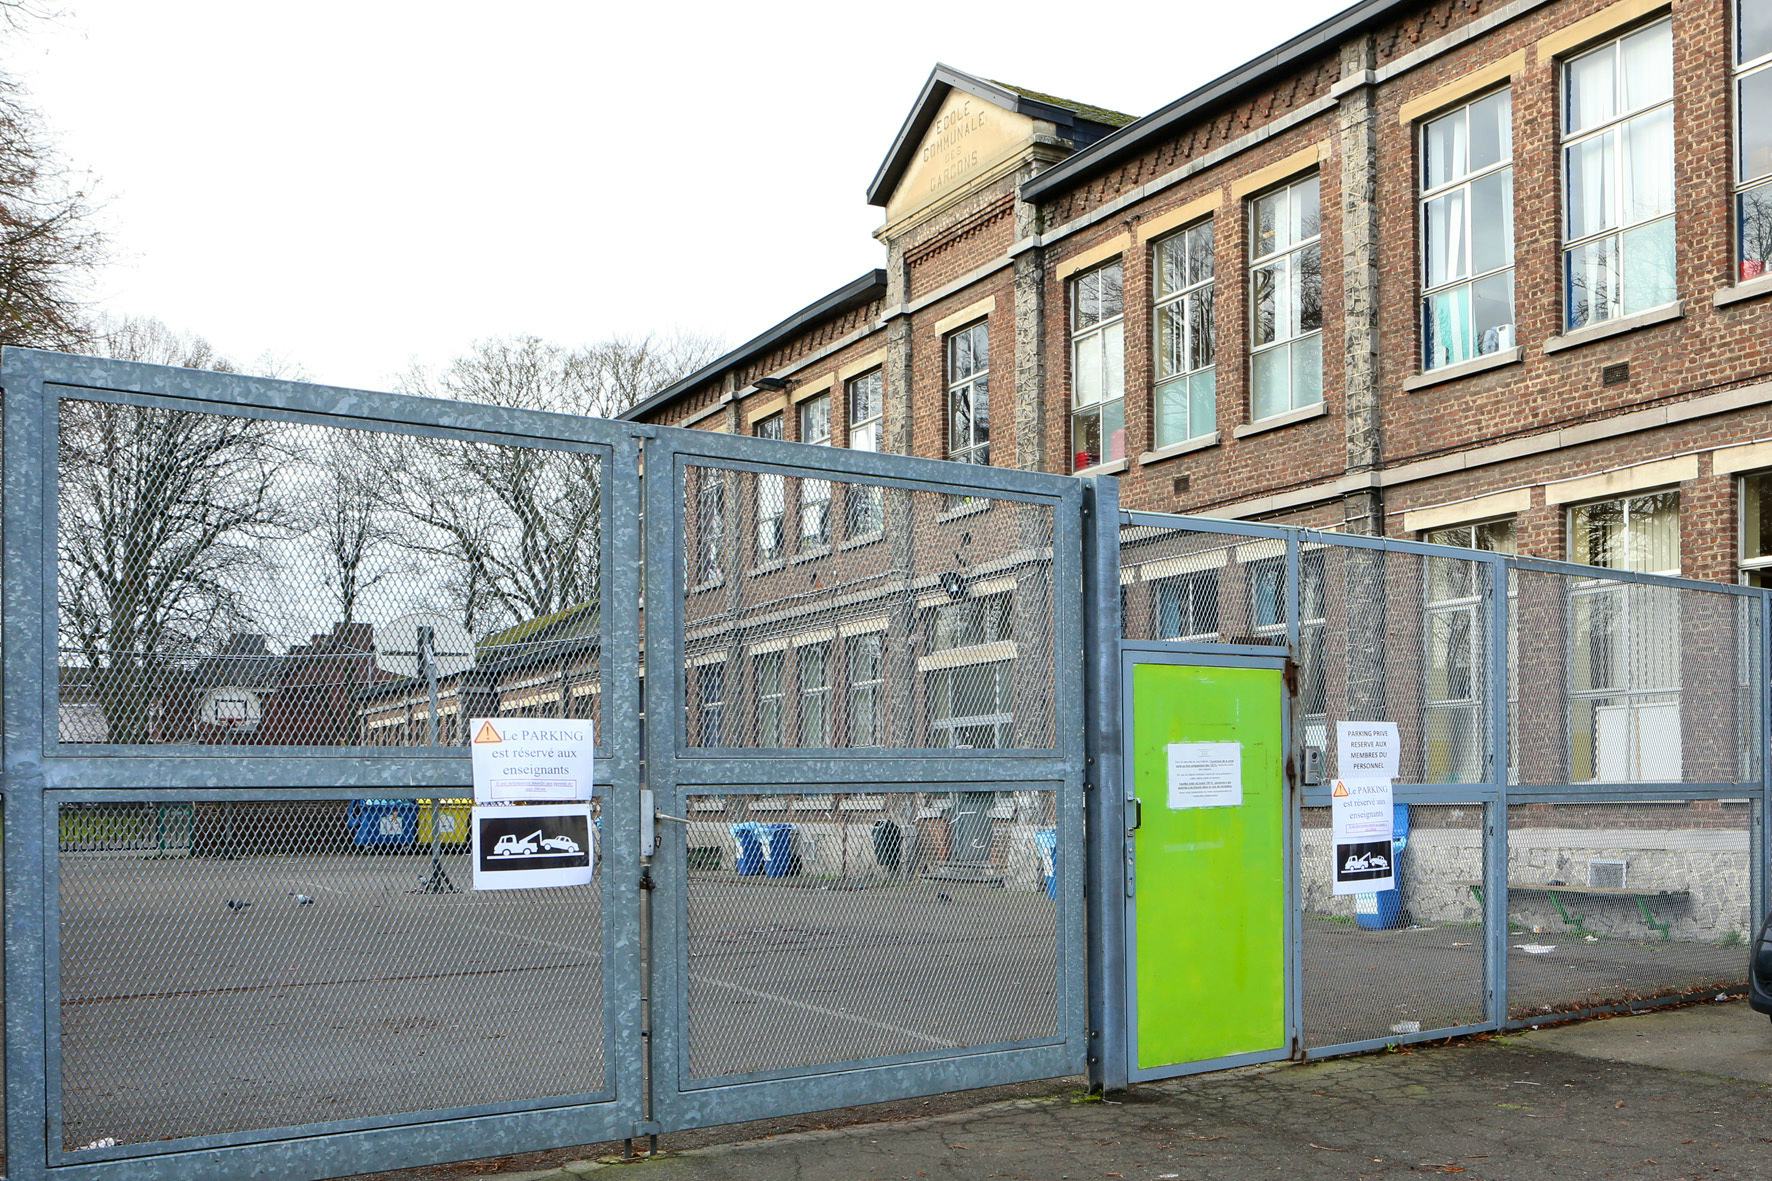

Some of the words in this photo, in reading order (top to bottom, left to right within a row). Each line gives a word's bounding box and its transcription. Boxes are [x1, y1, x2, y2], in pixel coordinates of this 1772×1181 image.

[936, 100, 970, 135] ECOLE
[923, 111, 985, 162] COMMUNALE
[502, 730, 518, 741] Le
[522, 730, 584, 741] PARKING
[491, 749, 511, 758] est
[512, 747, 555, 758] réservé
[557, 750, 577, 758] aux
[1350, 751, 1379, 759] MEMBRES
[502, 764, 570, 777] enseignants
[1353, 762, 1384, 770] PERSONNEL
[1357, 785, 1388, 794] PARKING
[1343, 800, 1353, 808] est
[1349, 810, 1384, 819] enseignants
